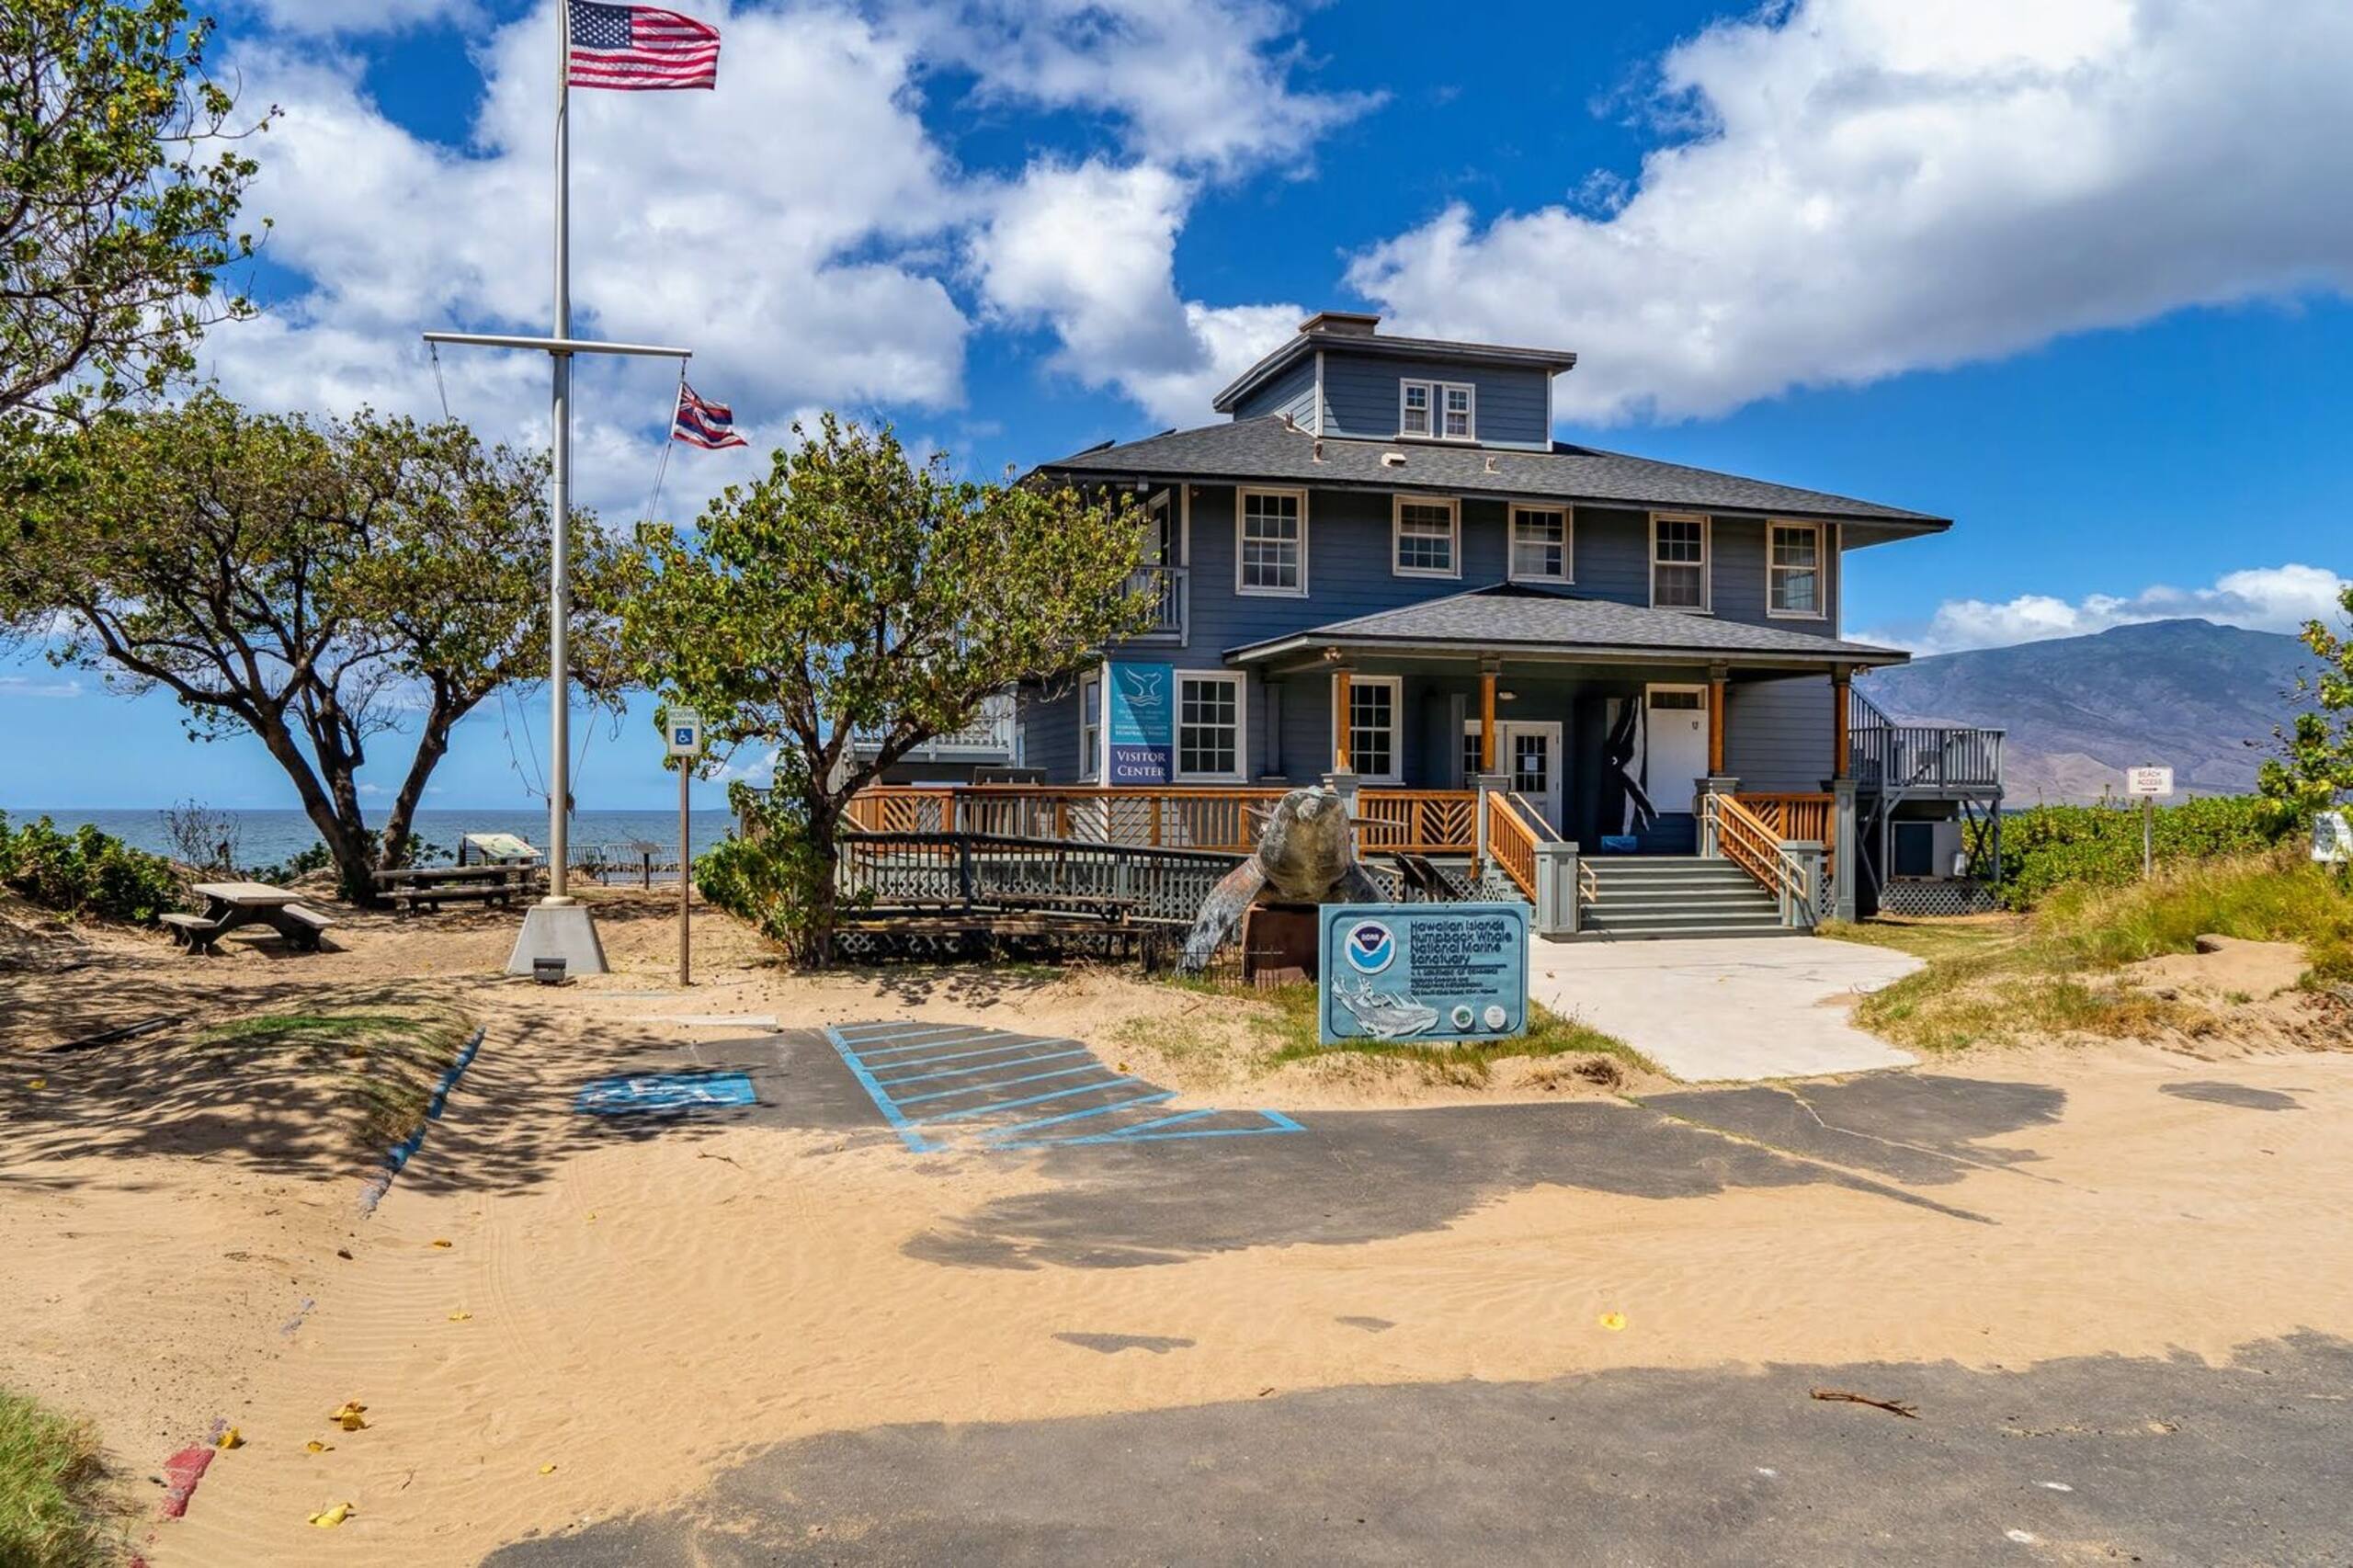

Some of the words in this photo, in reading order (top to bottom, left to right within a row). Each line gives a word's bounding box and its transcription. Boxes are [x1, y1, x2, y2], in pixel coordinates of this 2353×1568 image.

[1117, 751, 1165, 762] VISITOR
[1117, 765, 1165, 777] CENTER
[1411, 921, 1463, 931] Hawaiian
[1466, 920, 1505, 931] Islands
[1411, 932, 1474, 943] Humpback
[1477, 932, 1512, 943] Whale
[1411, 943, 1460, 954] National
[1461, 942, 1501, 953] Marine
[1411, 954, 1470, 965] Sanctuary
